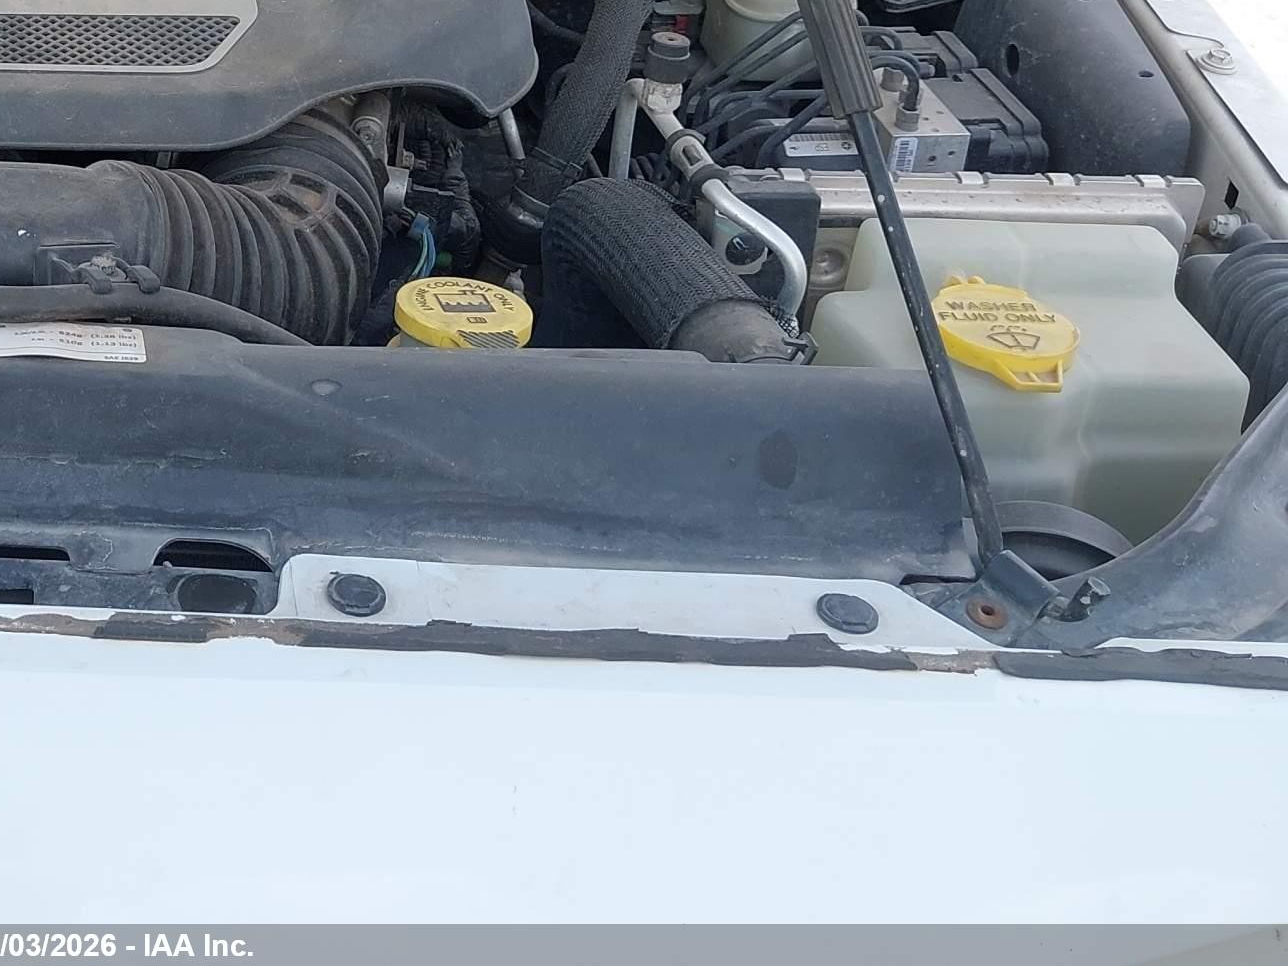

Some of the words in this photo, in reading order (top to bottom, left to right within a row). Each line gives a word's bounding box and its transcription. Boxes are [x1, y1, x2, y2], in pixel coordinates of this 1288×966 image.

[427, 281, 492, 293] COOLANT
[493, 293, 515, 312] ONLY
[945, 301, 1037, 312] WASHER
[938, 311, 998, 323] FLUID
[1005, 312, 1057, 324] ONLY
